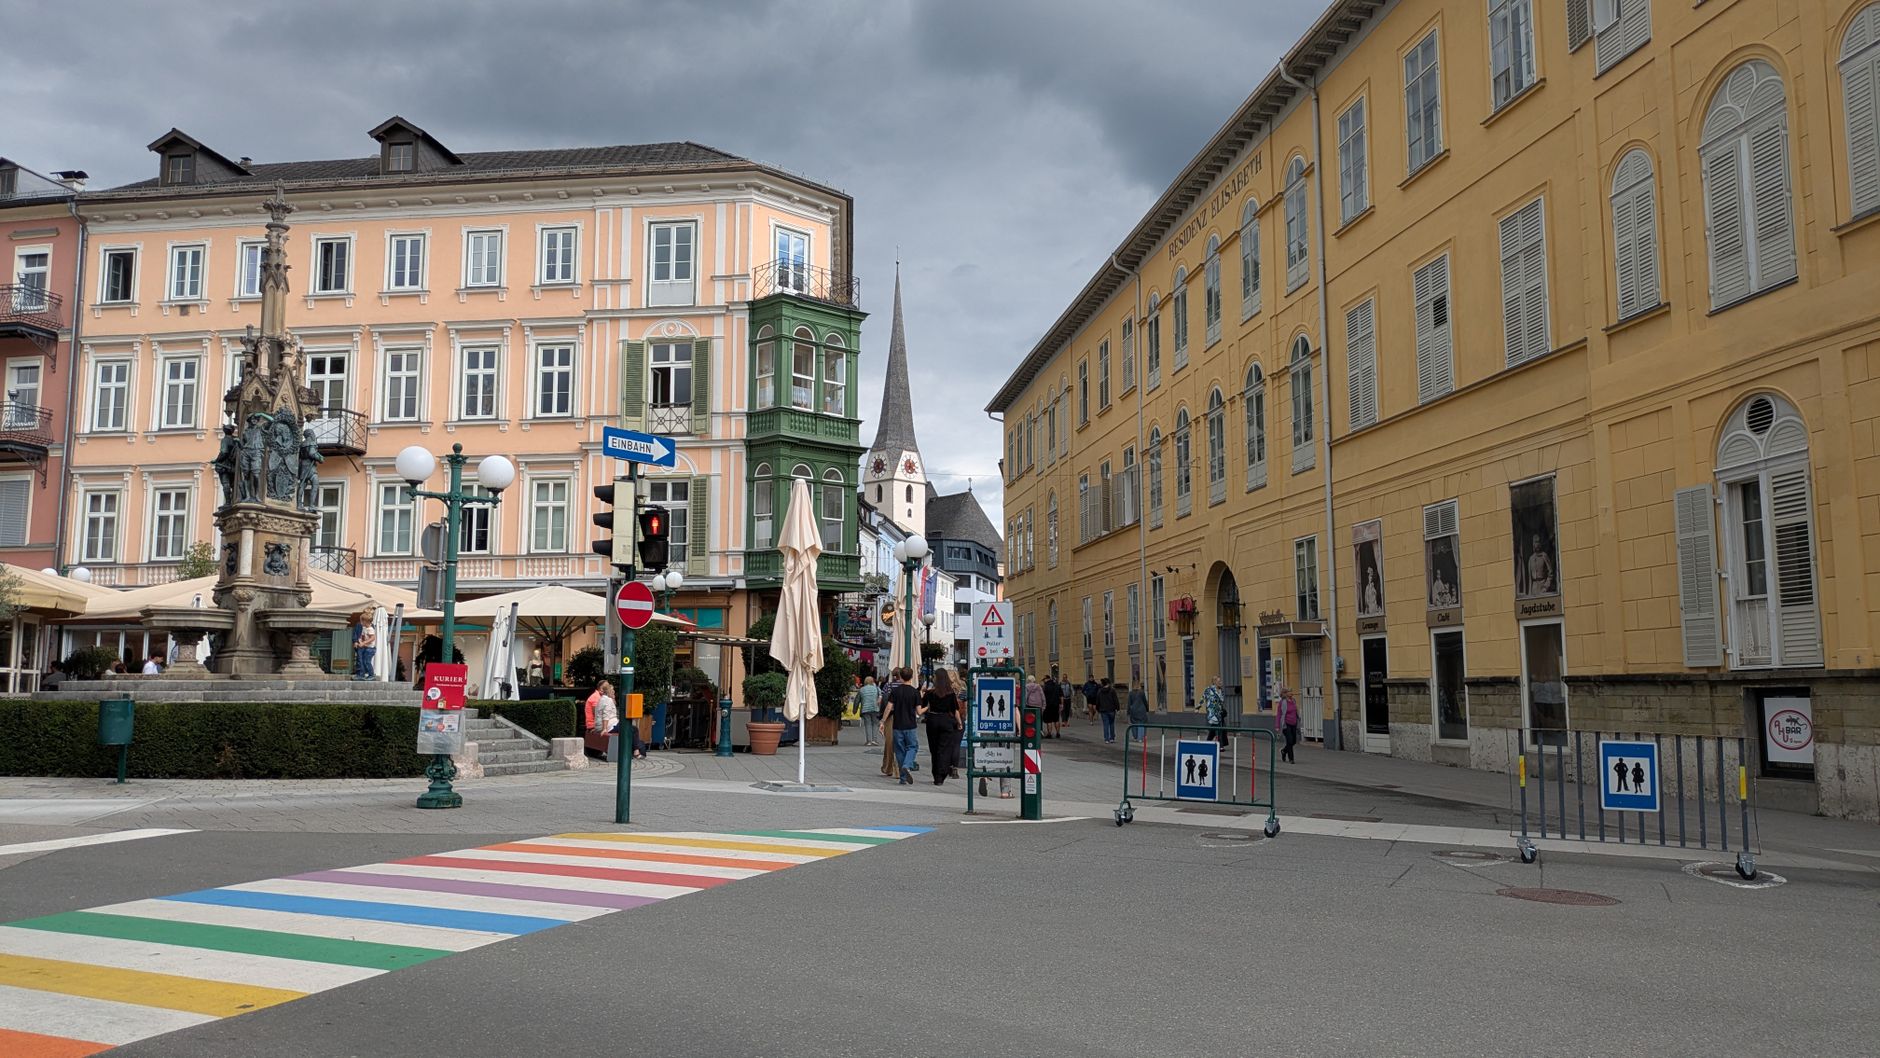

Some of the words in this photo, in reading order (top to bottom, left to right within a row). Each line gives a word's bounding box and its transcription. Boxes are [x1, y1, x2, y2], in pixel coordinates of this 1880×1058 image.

[1168, 208, 1208, 261] RESIDENZ
[1211, 151, 1263, 219] ELISABETH
[611, 437, 652, 454] EINBAHN
[1520, 601, 1556, 616] Jagdstube
[433, 675, 464, 683] KURIER
[1785, 726, 1802, 734] BAR
